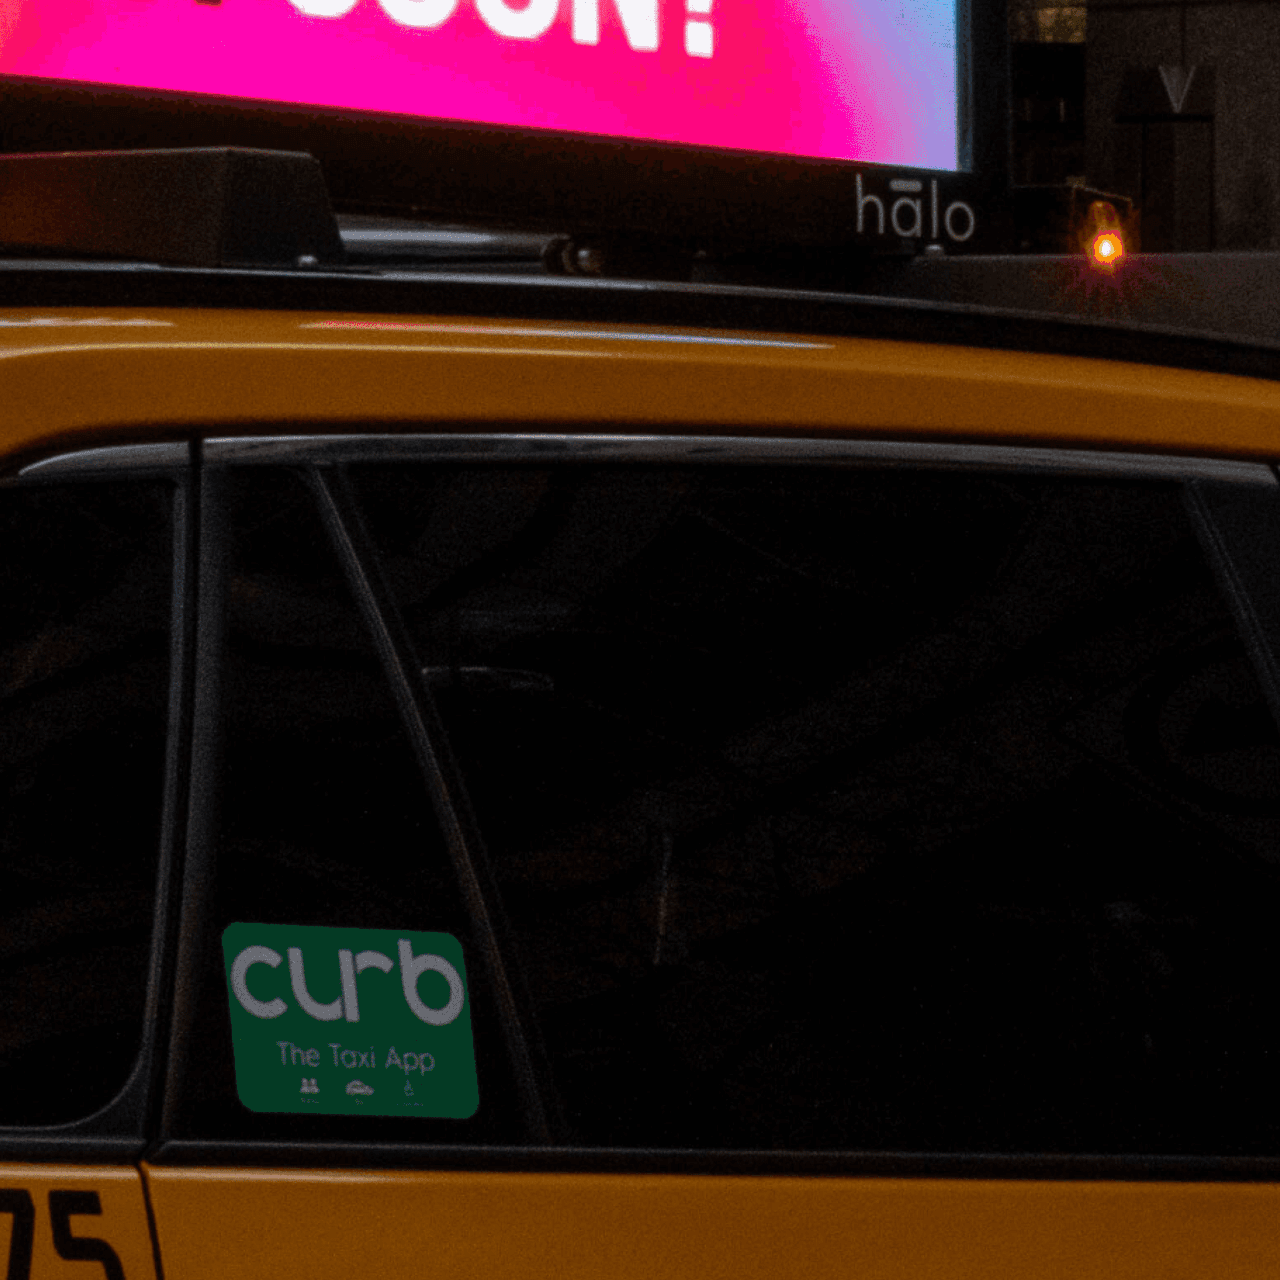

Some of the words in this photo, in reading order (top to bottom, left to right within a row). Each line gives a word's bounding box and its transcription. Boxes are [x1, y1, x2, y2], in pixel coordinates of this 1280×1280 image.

[230, 937, 465, 1026] curb
[276, 1040, 321, 1068] The
[327, 1042, 376, 1069] Taxi
[385, 1046, 436, 1076] App
